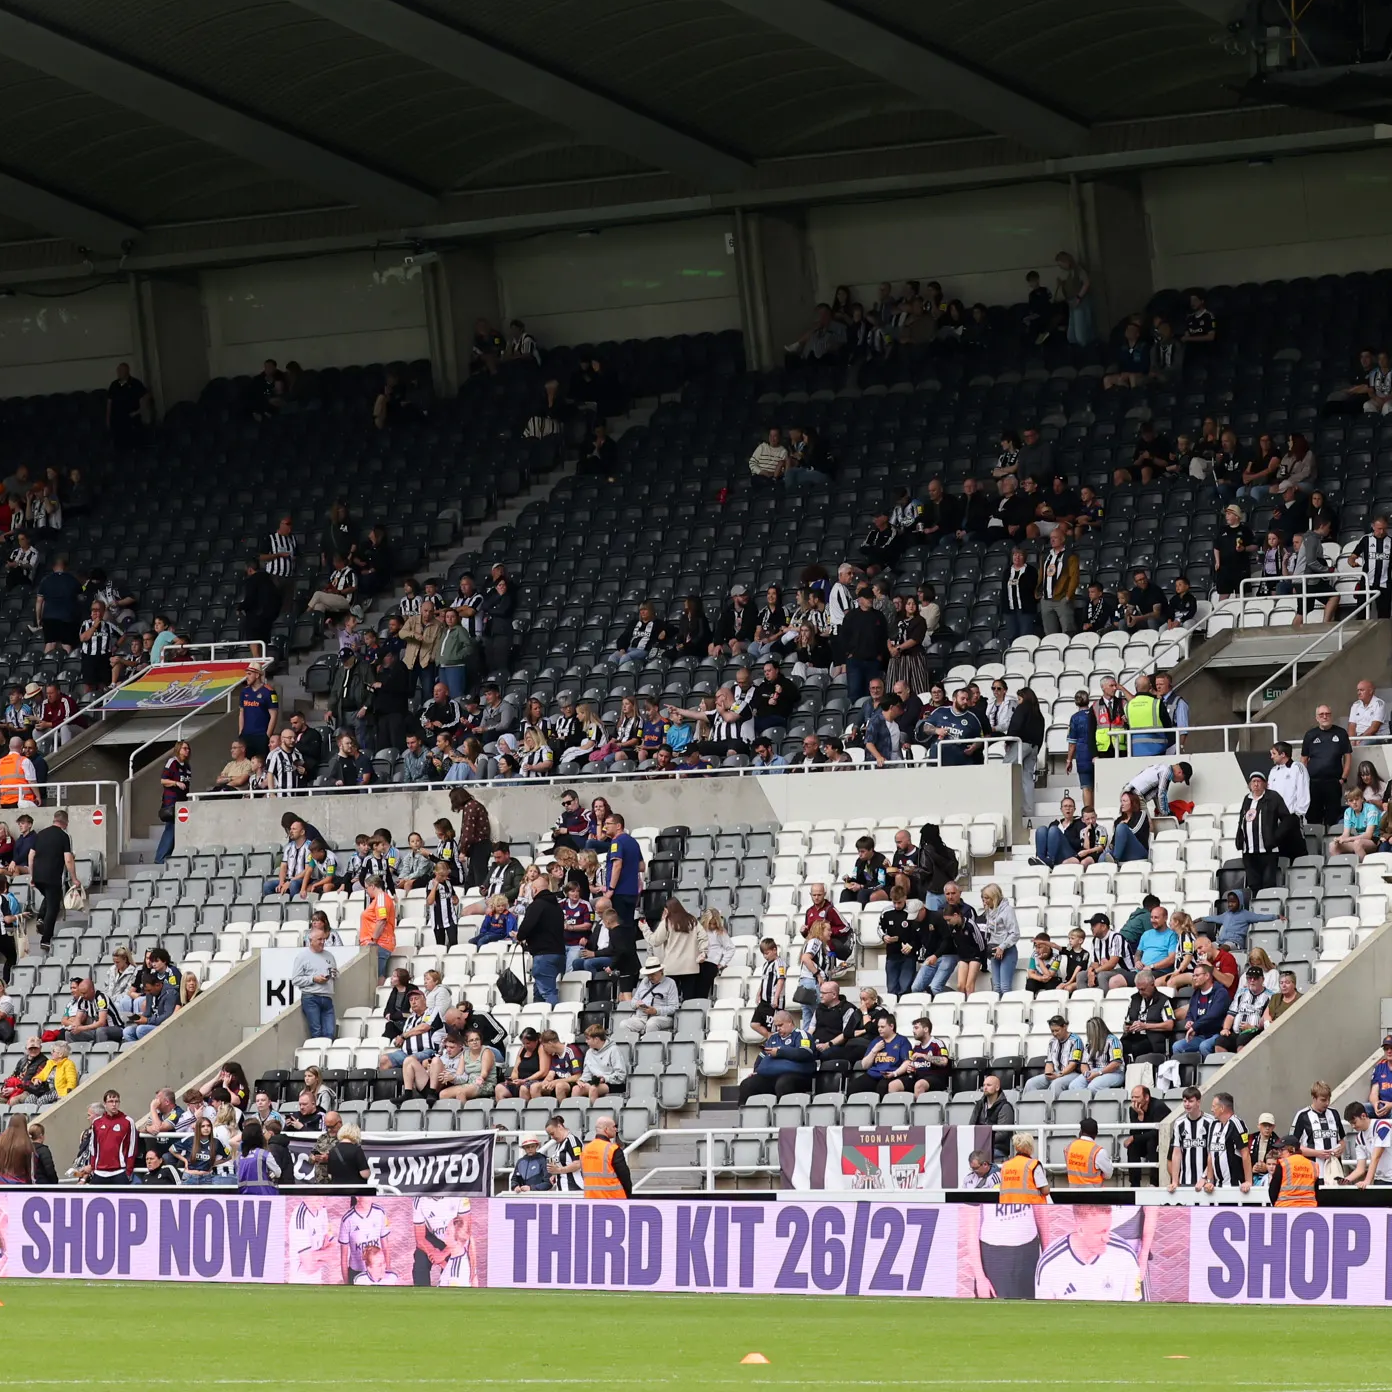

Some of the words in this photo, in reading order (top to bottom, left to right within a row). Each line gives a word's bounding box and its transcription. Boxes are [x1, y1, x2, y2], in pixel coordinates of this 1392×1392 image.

[387, 1152, 480, 1185] UNITED
[859, 1134, 883, 1144] TOON
[884, 1133, 908, 1143] ARMY
[21, 1196, 148, 1276] SHOP
[159, 1198, 272, 1278] NOW
[504, 1202, 663, 1286] THIRD
[675, 1205, 765, 1288] KIT
[773, 1200, 940, 1297] 26/27
[1207, 1210, 1371, 1301] SHOP
